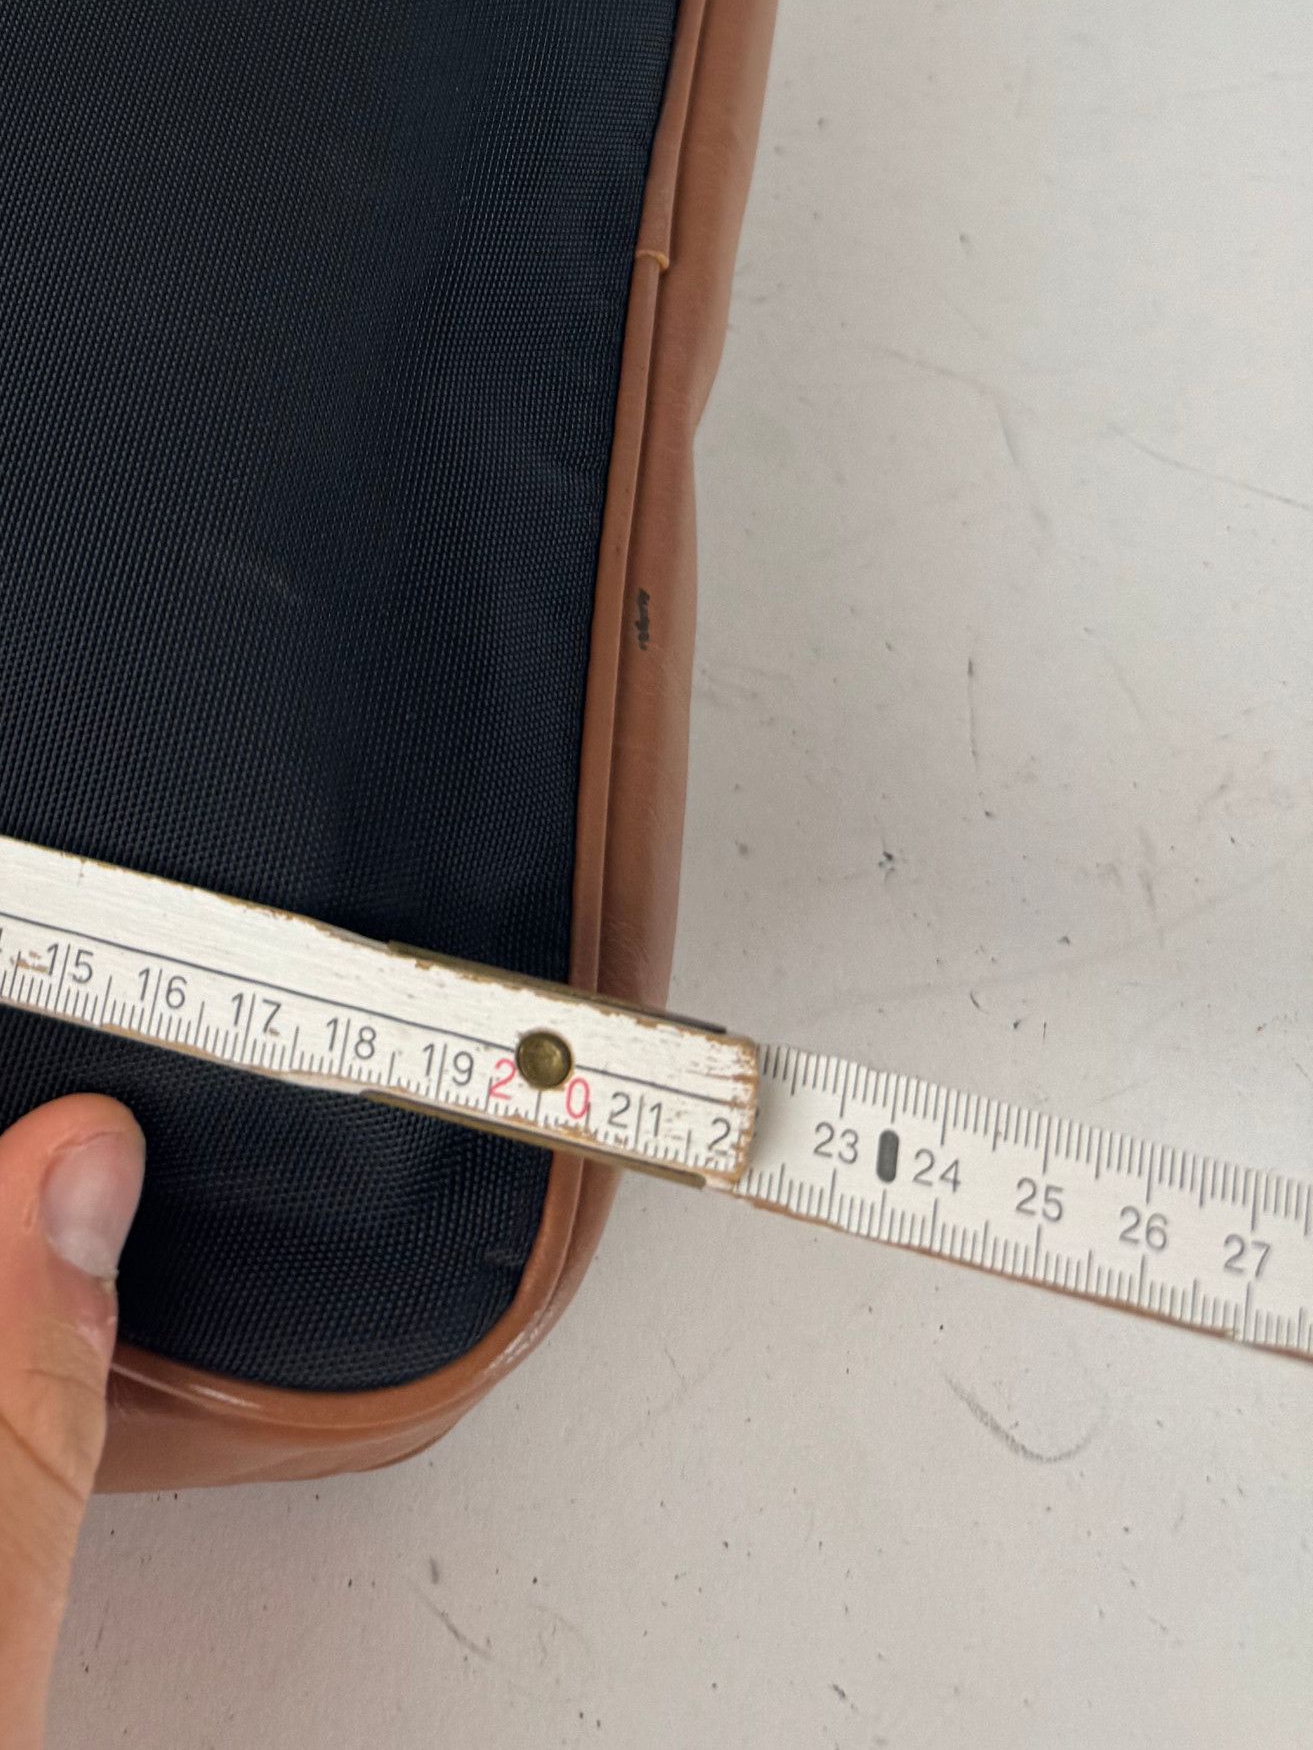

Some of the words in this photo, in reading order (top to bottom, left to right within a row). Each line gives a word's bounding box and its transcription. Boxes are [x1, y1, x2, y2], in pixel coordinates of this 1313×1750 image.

[45, 942, 95, 986] 15
[137, 968, 189, 1010] 16
[231, 993, 282, 1035] 17
[325, 1017, 378, 1061] 18
[422, 1043, 475, 1087] 19
[606, 1091, 664, 1137] 21
[812, 1121, 861, 1166] 23
[911, 1148, 962, 1195] 24
[1014, 1176, 1065, 1224] 25
[1118, 1205, 1170, 1252] 26
[1222, 1233, 1272, 1280] 27
